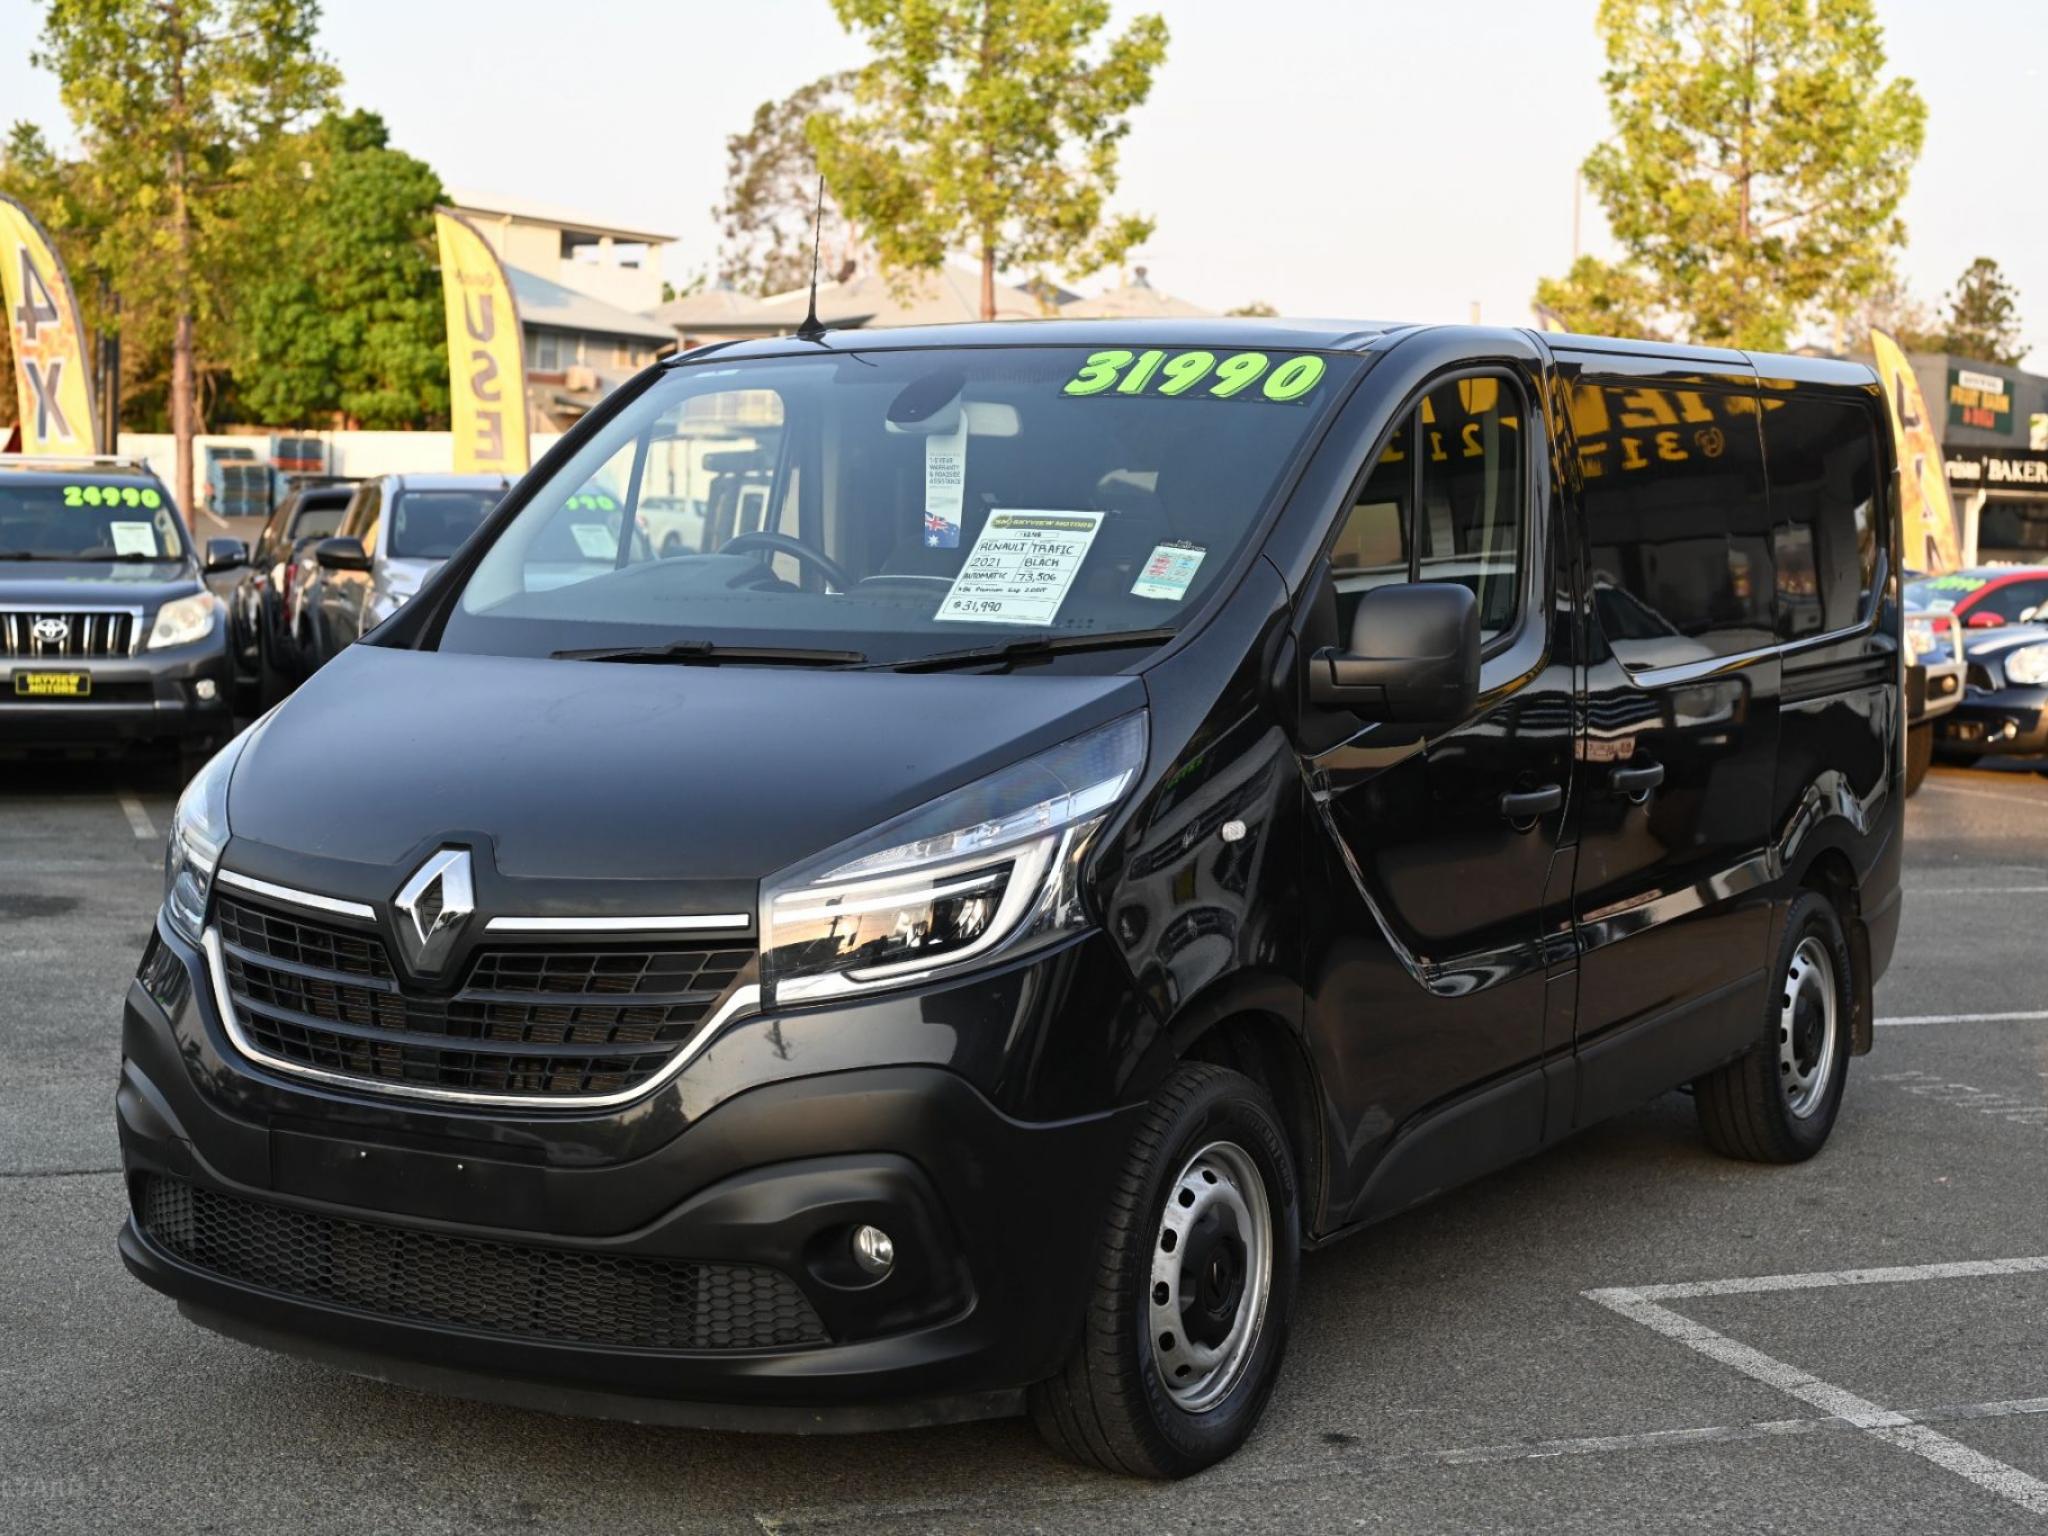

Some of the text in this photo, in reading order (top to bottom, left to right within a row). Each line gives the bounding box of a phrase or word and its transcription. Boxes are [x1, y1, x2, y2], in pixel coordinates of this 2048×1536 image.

[1064, 350, 1326, 401] 31990
[980, 542, 1074, 555] RENAULT TRAFIC
[970, 557, 1059, 567] 2021 BLACK
[963, 572, 1057, 582] AUTOMATIC 73,506
